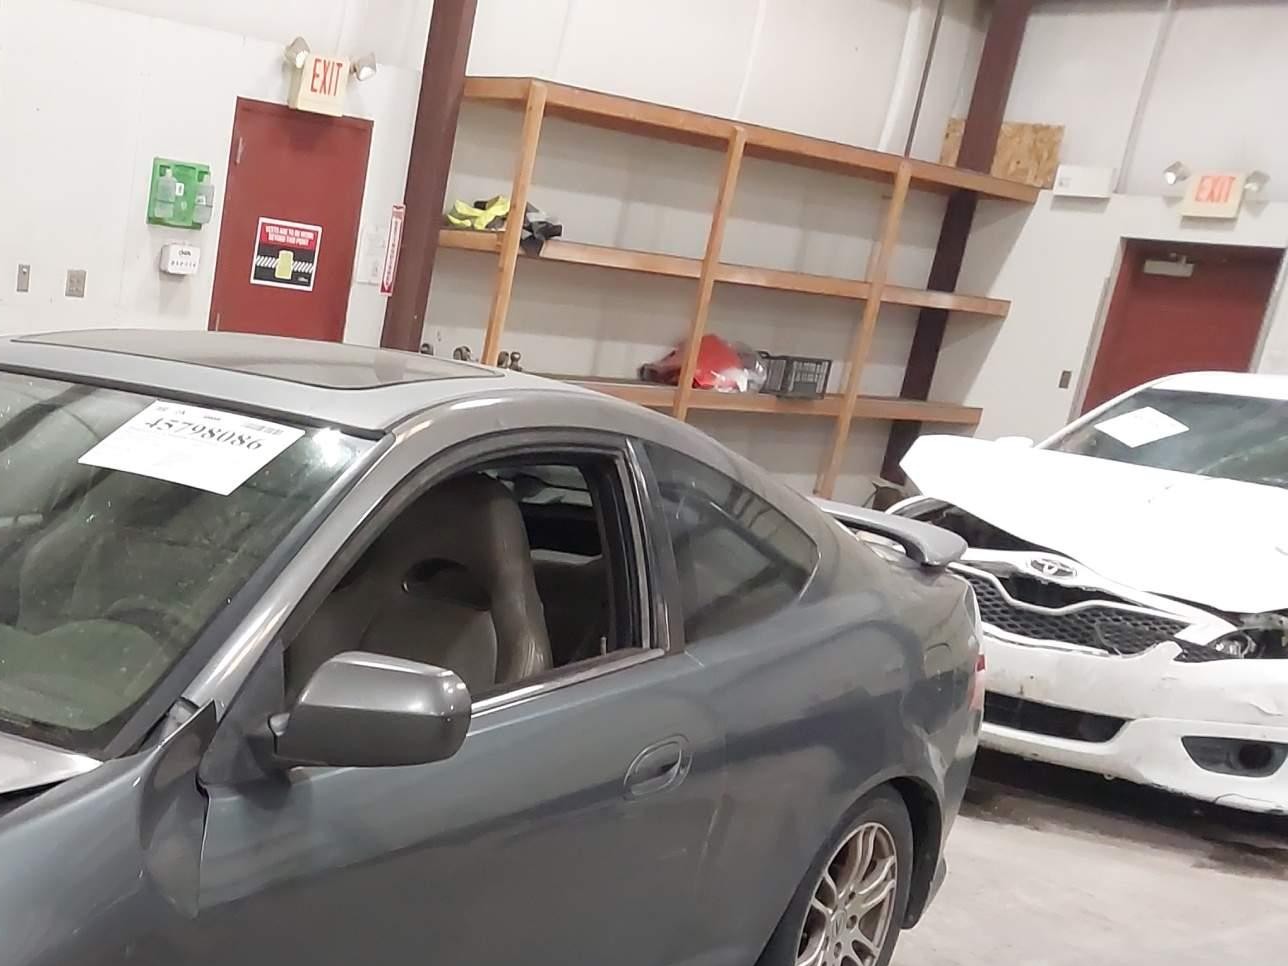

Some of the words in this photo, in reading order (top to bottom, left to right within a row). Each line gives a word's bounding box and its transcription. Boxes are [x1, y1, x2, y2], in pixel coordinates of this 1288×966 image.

[310, 57, 343, 96] EXIT
[1195, 175, 1236, 203] EXIT
[145, 417, 262, 450] 45798086
